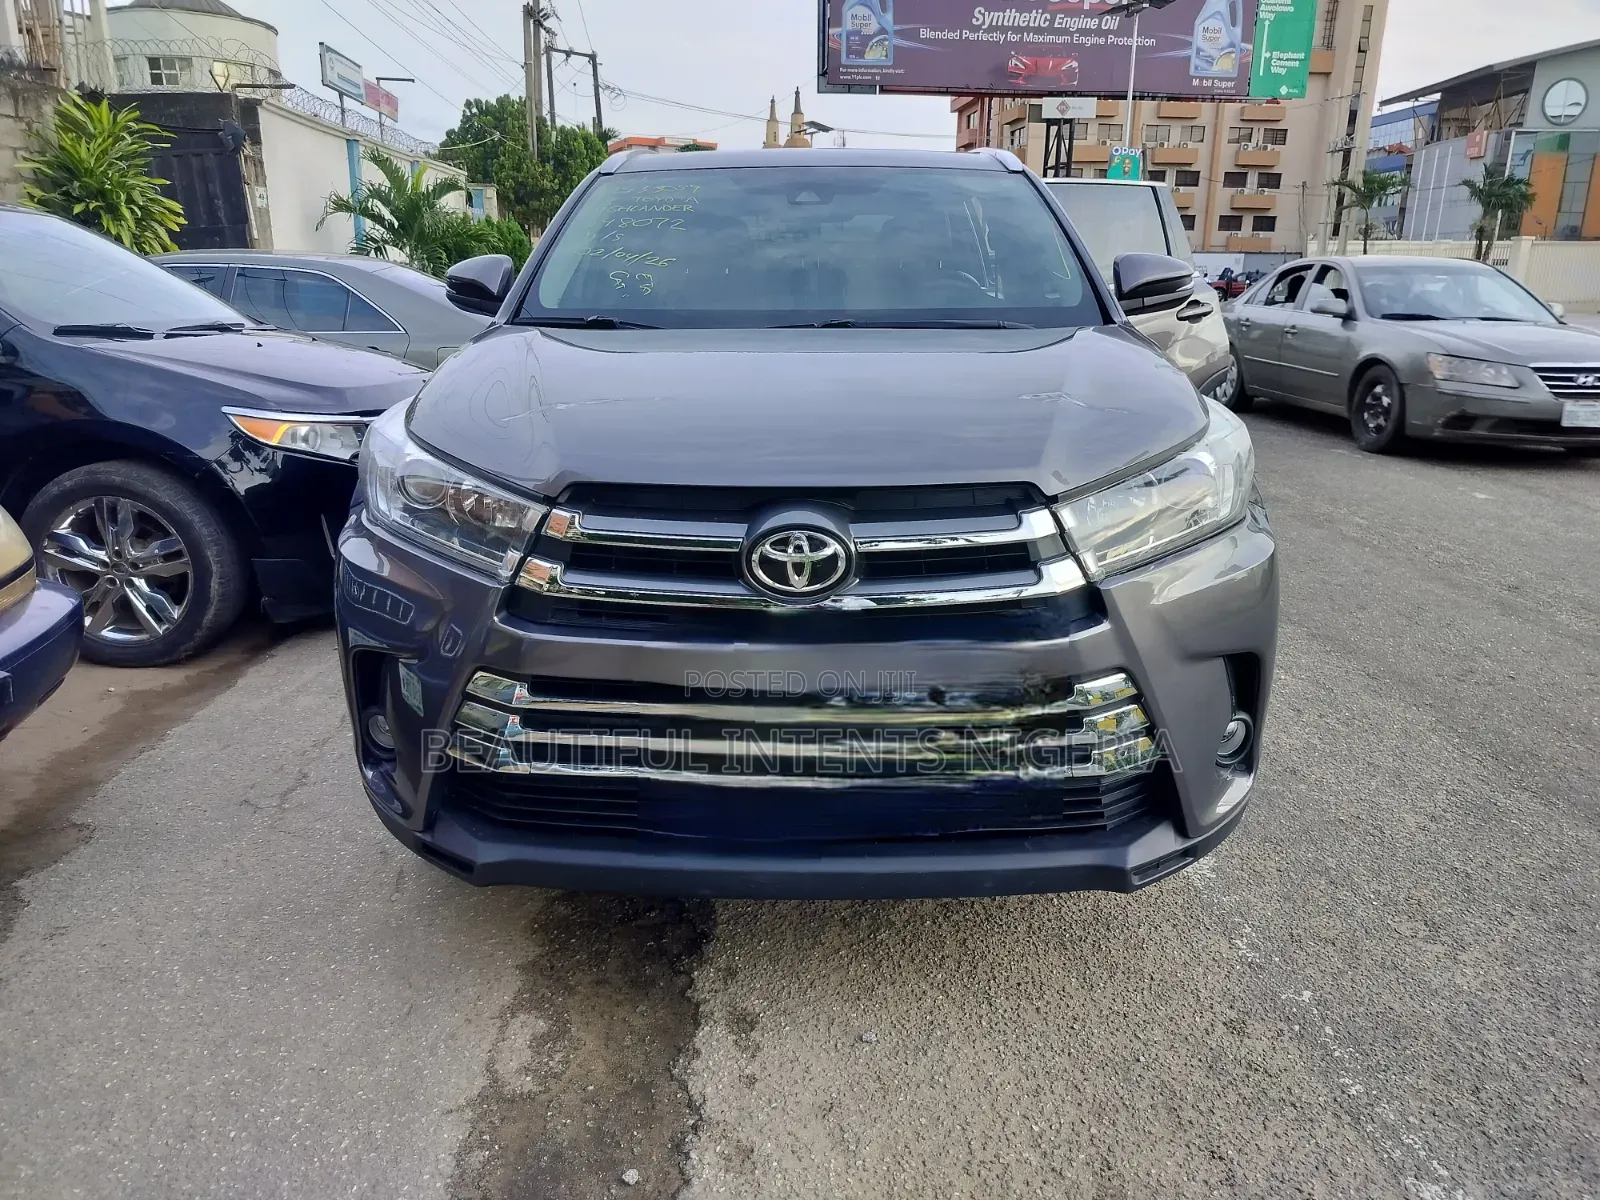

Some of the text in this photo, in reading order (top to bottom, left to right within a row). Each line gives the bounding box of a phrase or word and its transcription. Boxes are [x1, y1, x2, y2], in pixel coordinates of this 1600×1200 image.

[850, 13, 872, 22] Mobil
[971, 6, 1119, 31] Synthetic Engine Oil
[1260, 11, 1276, 20] Way
[850, 21, 872, 29] Super
[1202, 26, 1222, 35] Mobil
[919, 28, 960, 40] Blended
[962, 30, 1006, 44] Perfectly
[1007, 32, 1022, 43] for
[1023, 32, 1071, 44] Maximum
[1073, 34, 1105, 47] Engine
[1201, 35, 1221, 43] Super
[1272, 51, 1305, 60] Elephant
[1271, 59, 1300, 67] Cement
[1271, 66, 1287, 75] Way
[1213, 79, 1236, 89] Super
